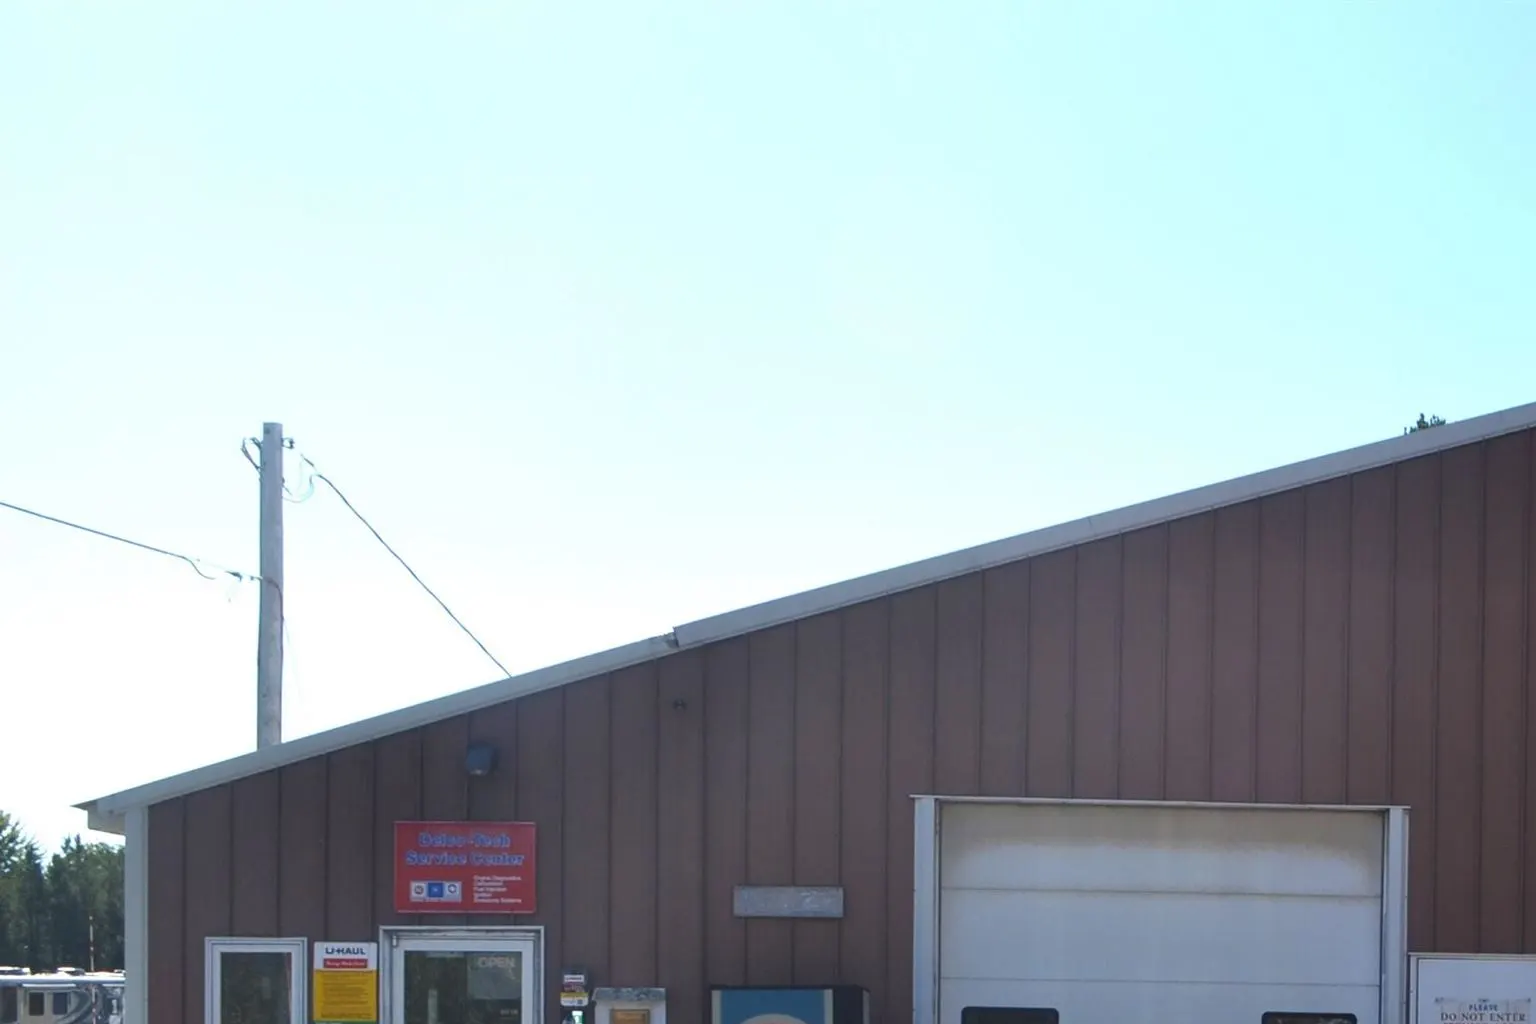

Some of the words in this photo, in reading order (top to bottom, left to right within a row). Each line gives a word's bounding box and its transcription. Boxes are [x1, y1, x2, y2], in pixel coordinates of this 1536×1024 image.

[406, 850, 468, 866] Service
[470, 851, 525, 866] Center
[478, 956, 516, 968] OPEN
[1469, 1004, 1498, 1012] PLEASE
[1440, 1012, 1457, 1022] DO
[1461, 1012, 1485, 1022] NOT
[1490, 1013, 1526, 1022] ENTER
